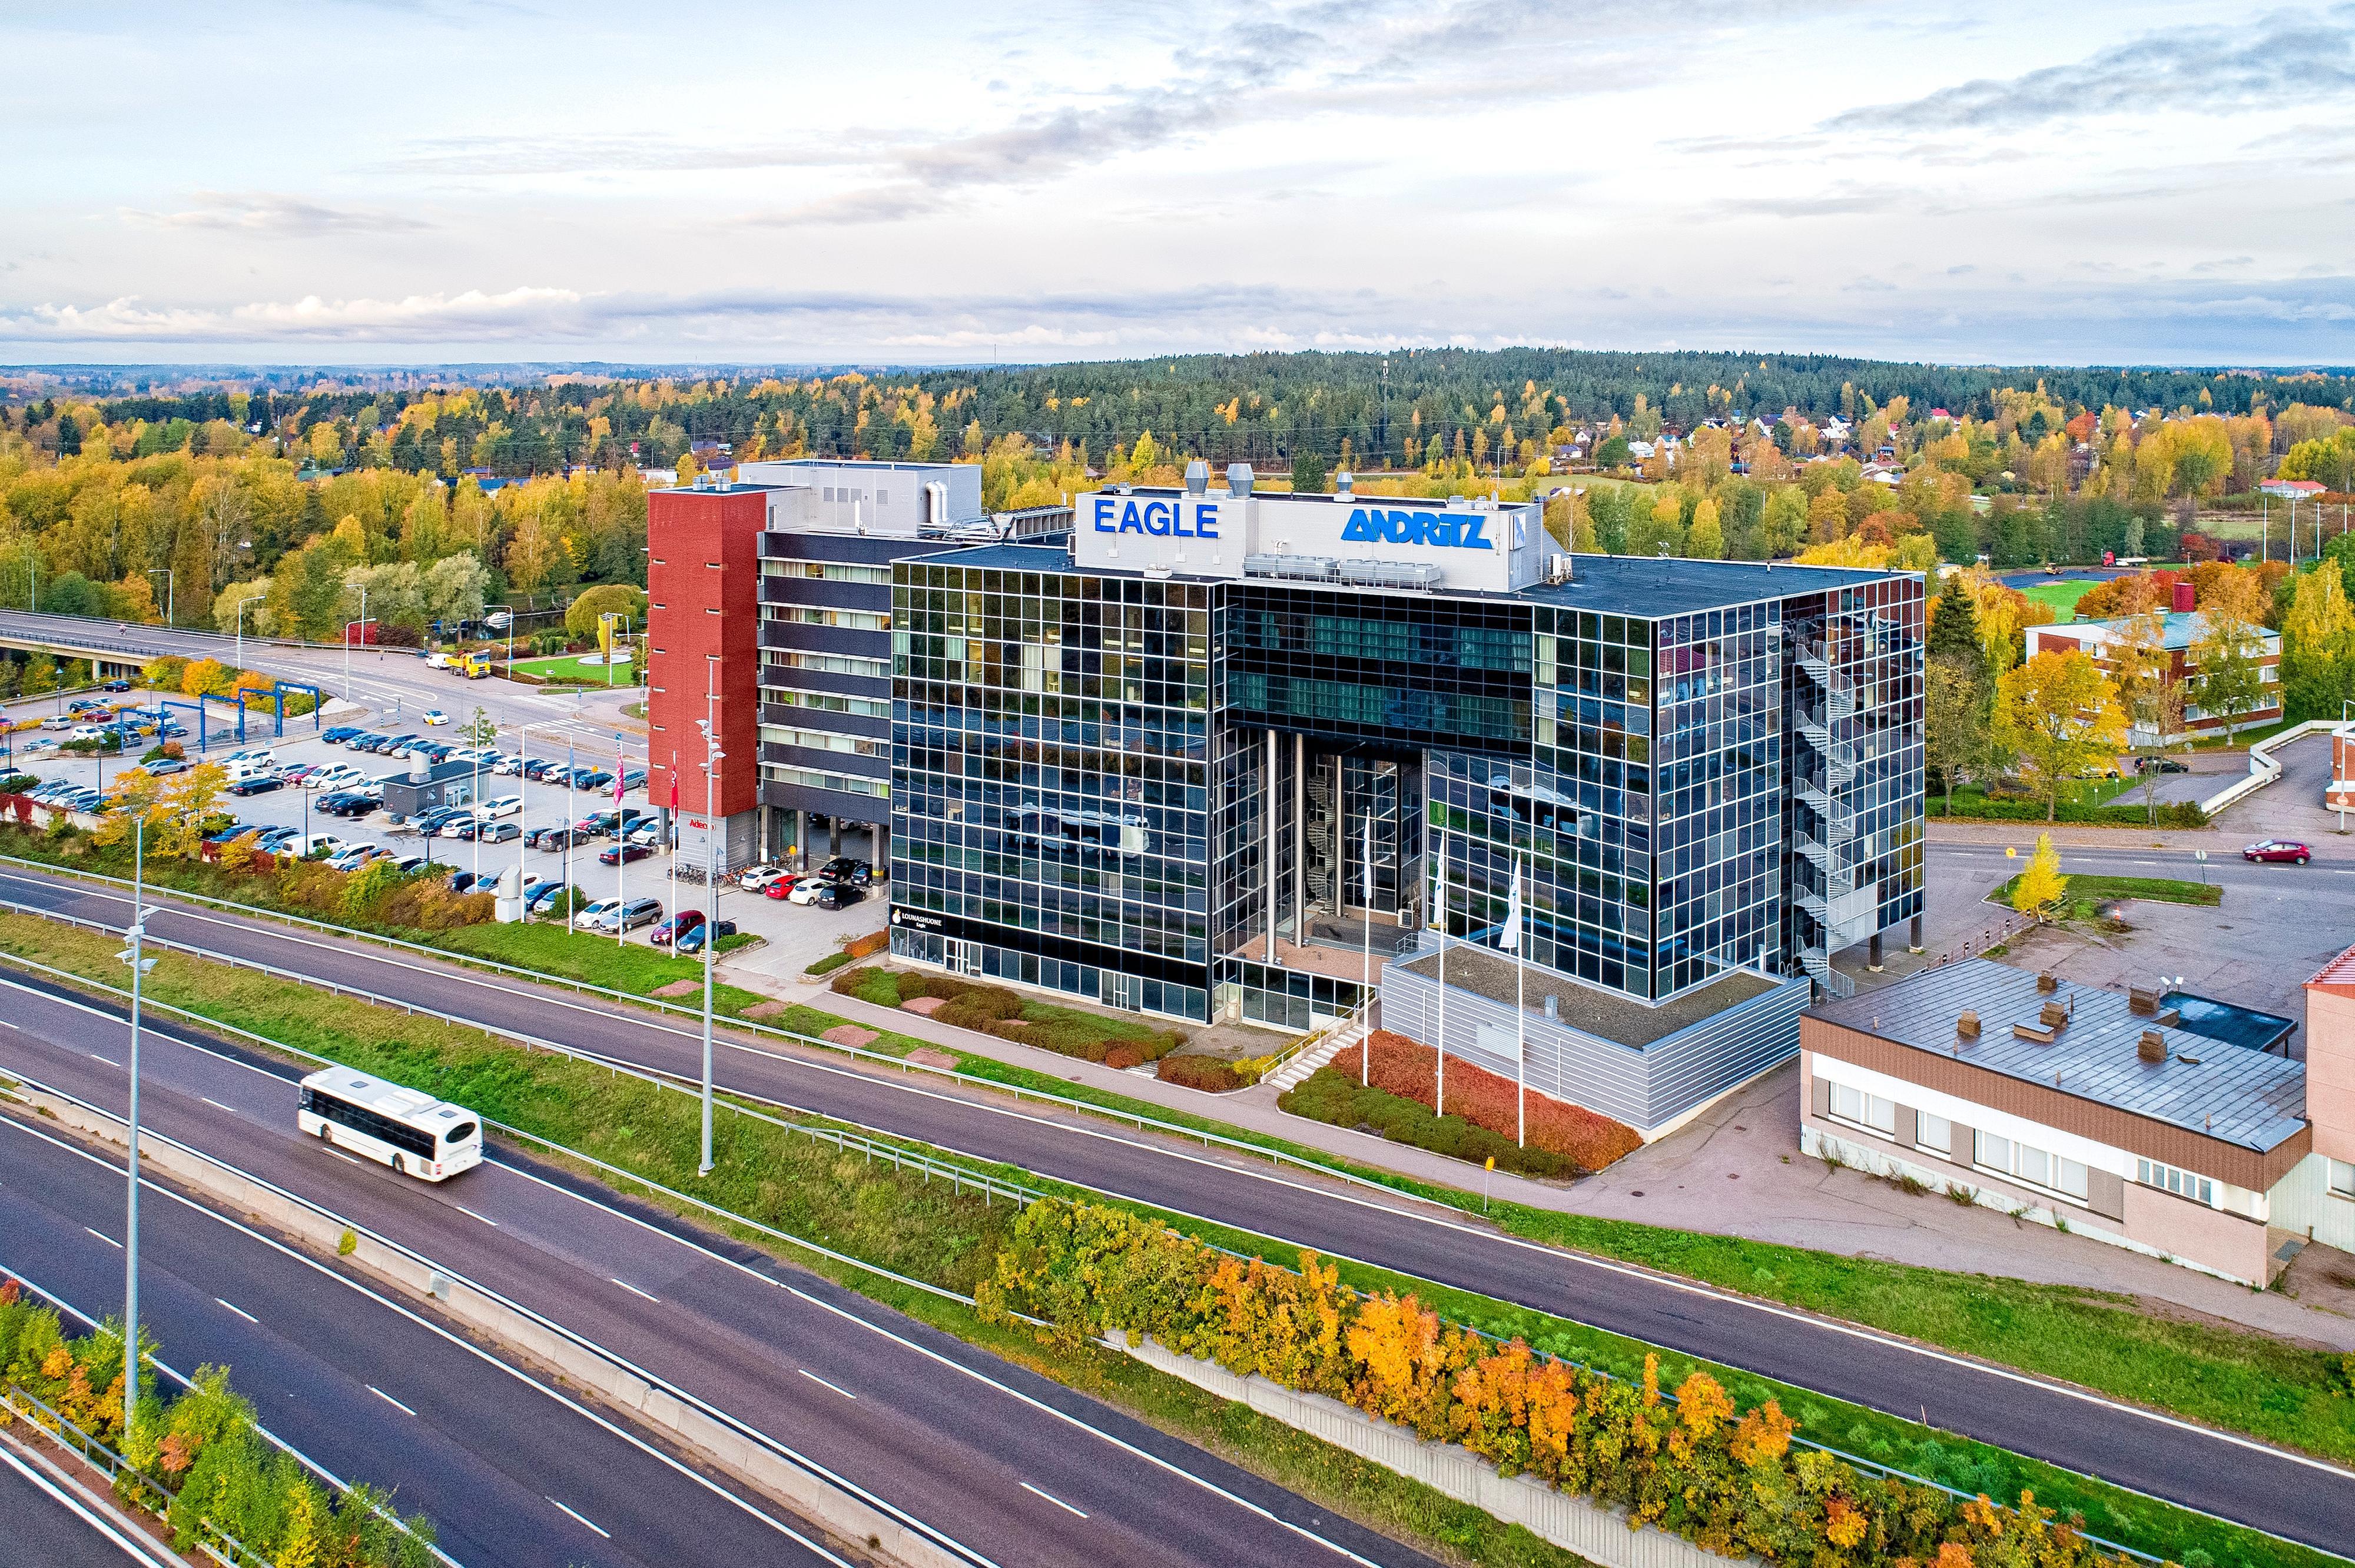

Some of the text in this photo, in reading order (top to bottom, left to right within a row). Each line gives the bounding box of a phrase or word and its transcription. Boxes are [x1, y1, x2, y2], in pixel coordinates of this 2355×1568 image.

[1095, 499, 1219, 539] EAGLE
[1341, 509, 1494, 549] ANDRITZ
[688, 818, 716, 831] Adeco
[901, 912, 942, 926] LOUNASHUONE
